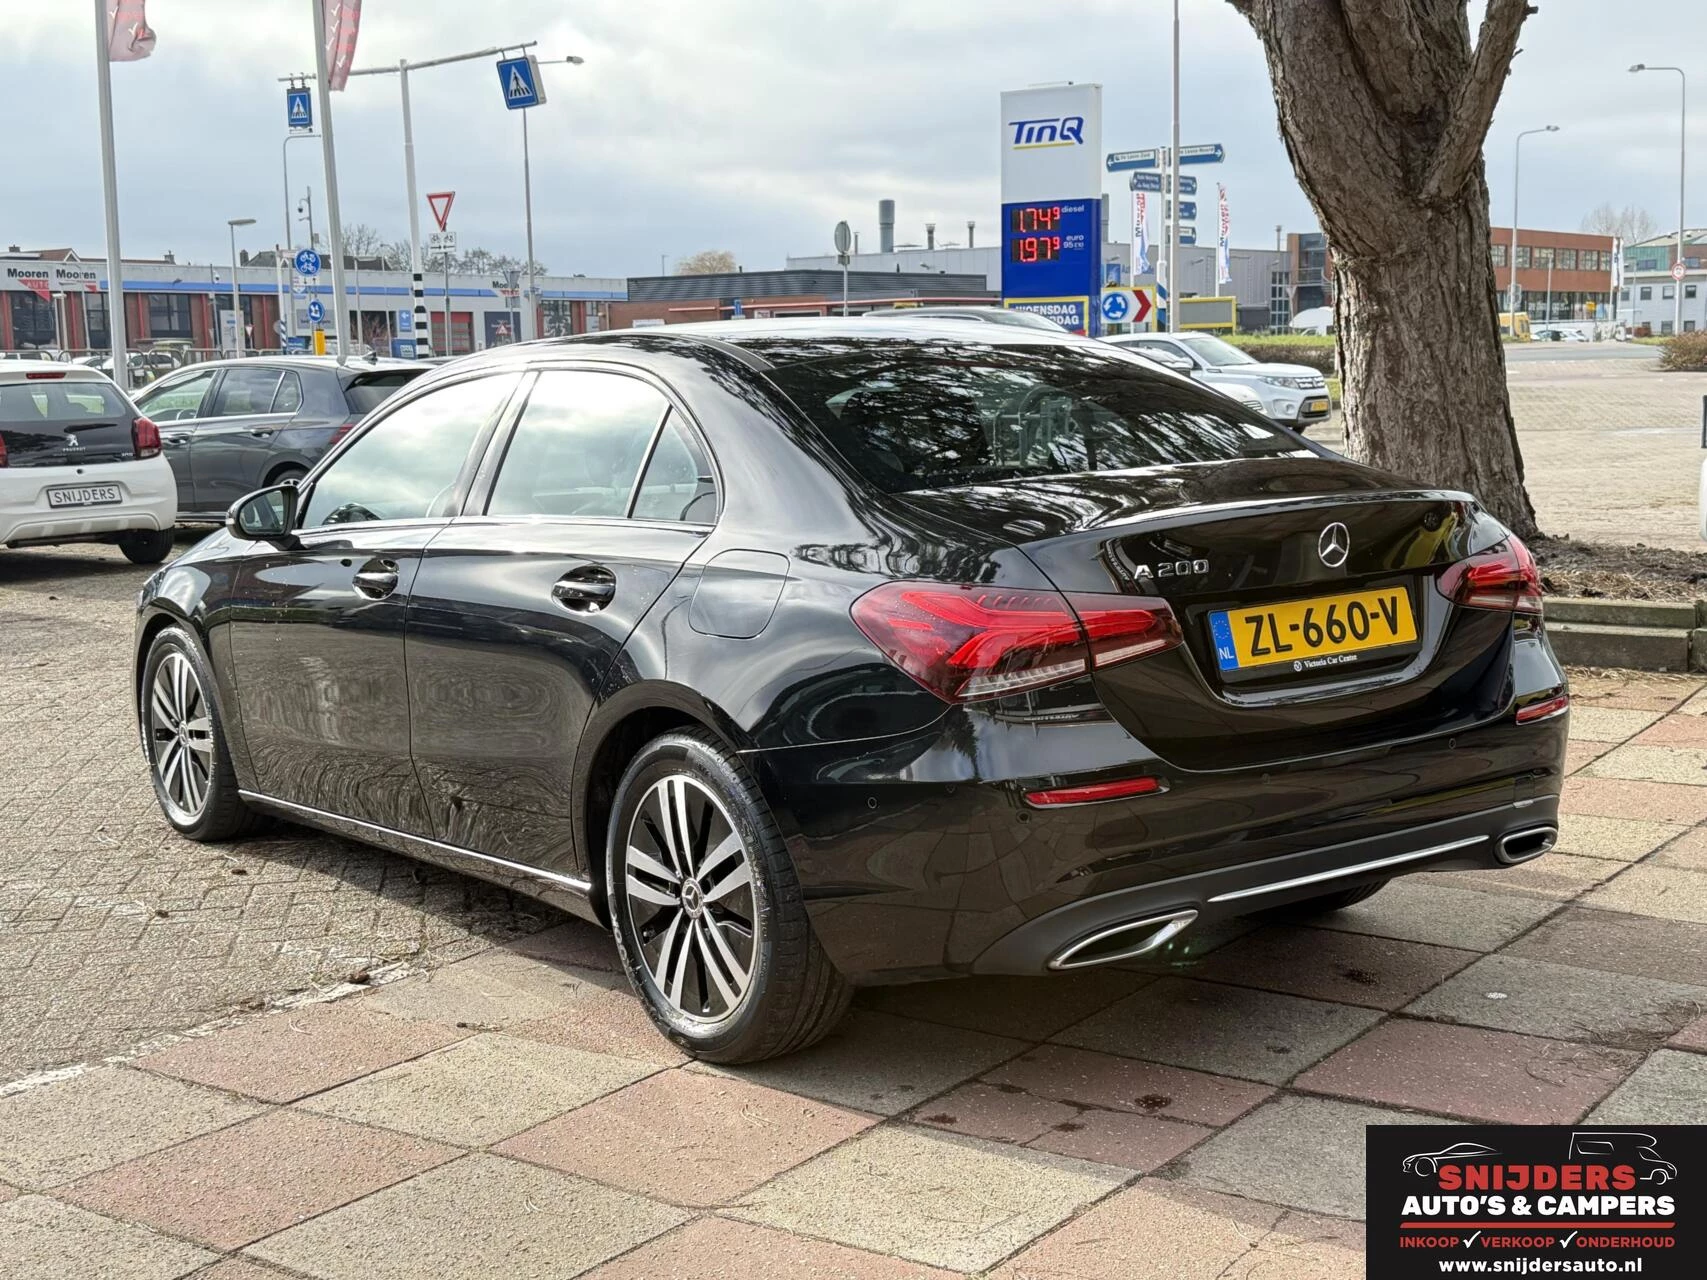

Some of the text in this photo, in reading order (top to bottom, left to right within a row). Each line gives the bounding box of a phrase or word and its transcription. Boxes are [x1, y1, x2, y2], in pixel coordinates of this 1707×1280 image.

[1061, 204, 1085, 213] diesel
[1066, 234, 1085, 242] euro
[1063, 241, 1074, 249] 95
[7, 268, 49, 279] Mooren
[54, 488, 116, 503] SNIJDERS
[1134, 559, 1210, 580] A 200
[1244, 596, 1399, 657] ZL-660-V
[1218, 646, 1235, 660] NL
[1303, 658, 1328, 669] Victoria
[1327, 656, 1338, 665] Car
